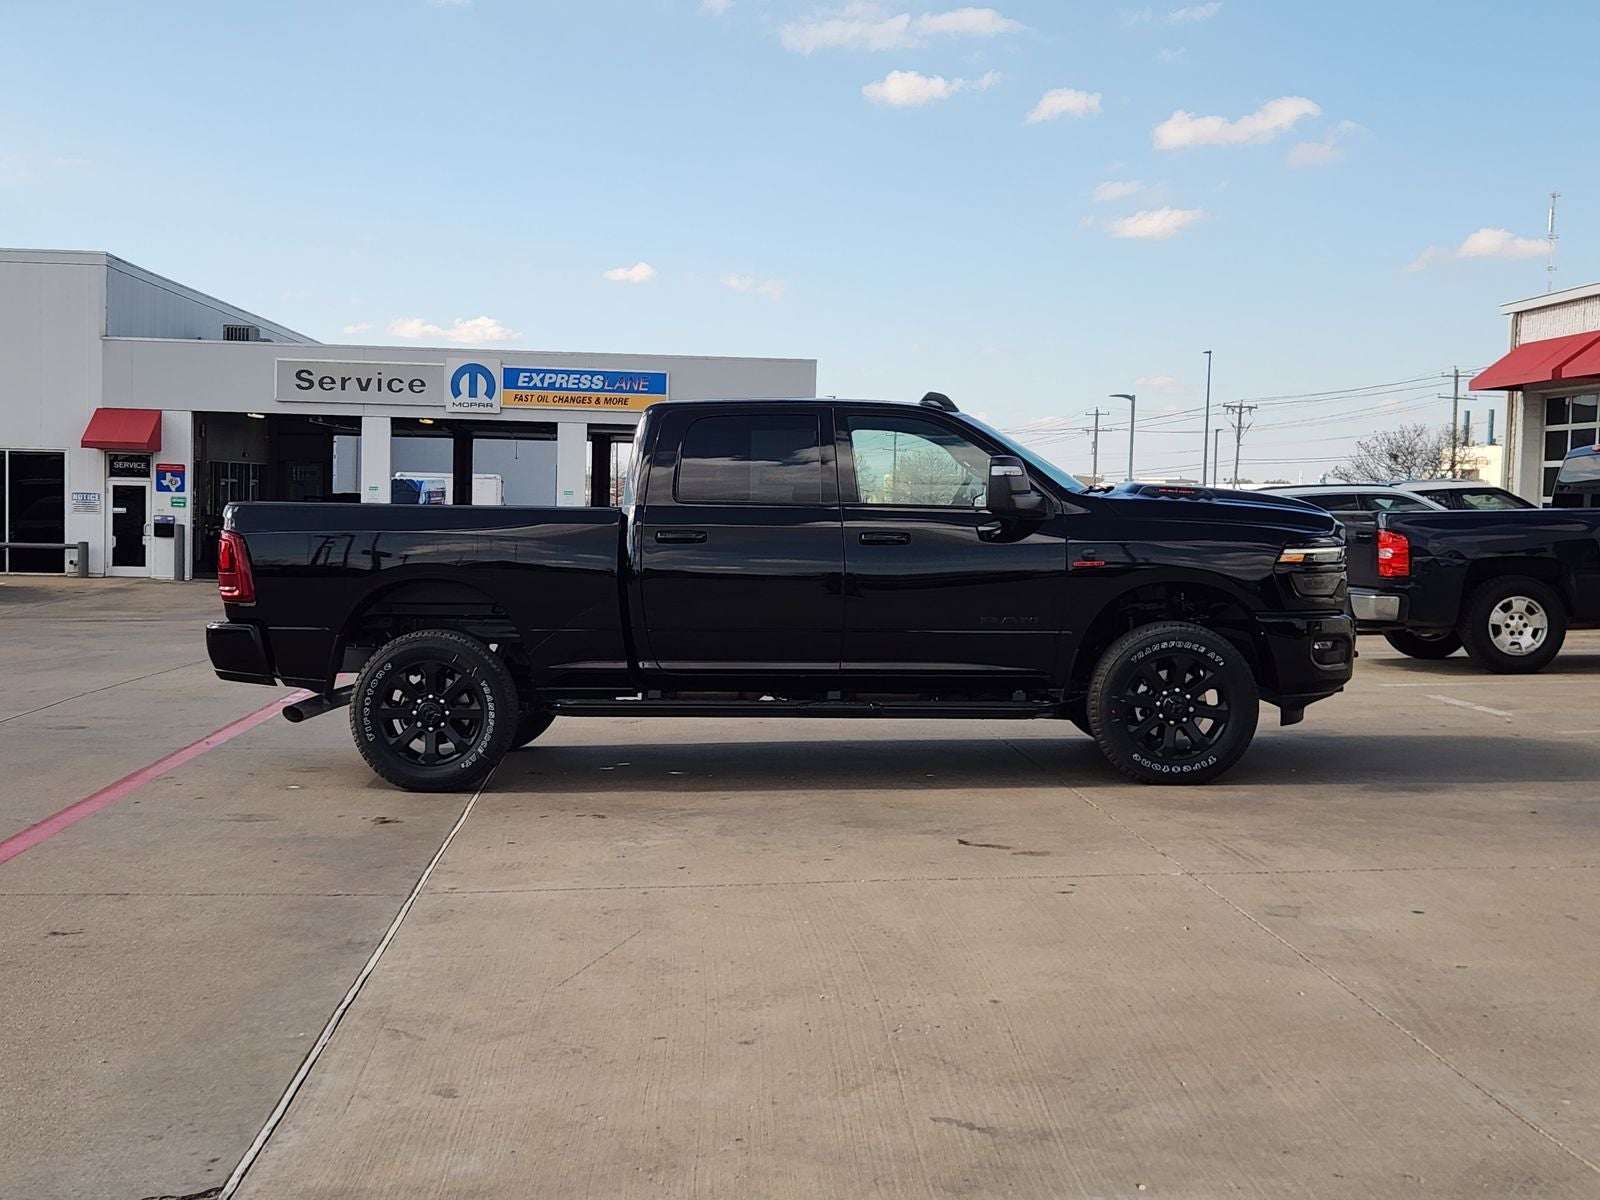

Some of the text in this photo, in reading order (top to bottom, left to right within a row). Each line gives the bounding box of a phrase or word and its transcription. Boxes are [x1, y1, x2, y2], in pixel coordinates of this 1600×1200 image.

[295, 369, 426, 394] Service
[517, 372, 649, 391] EXPRESSLANE
[513, 394, 629, 406] FAST OIL CHANGES & MORE
[113, 461, 147, 469] SERVICE
[1130, 641, 1206, 663] TRANSFORCE
